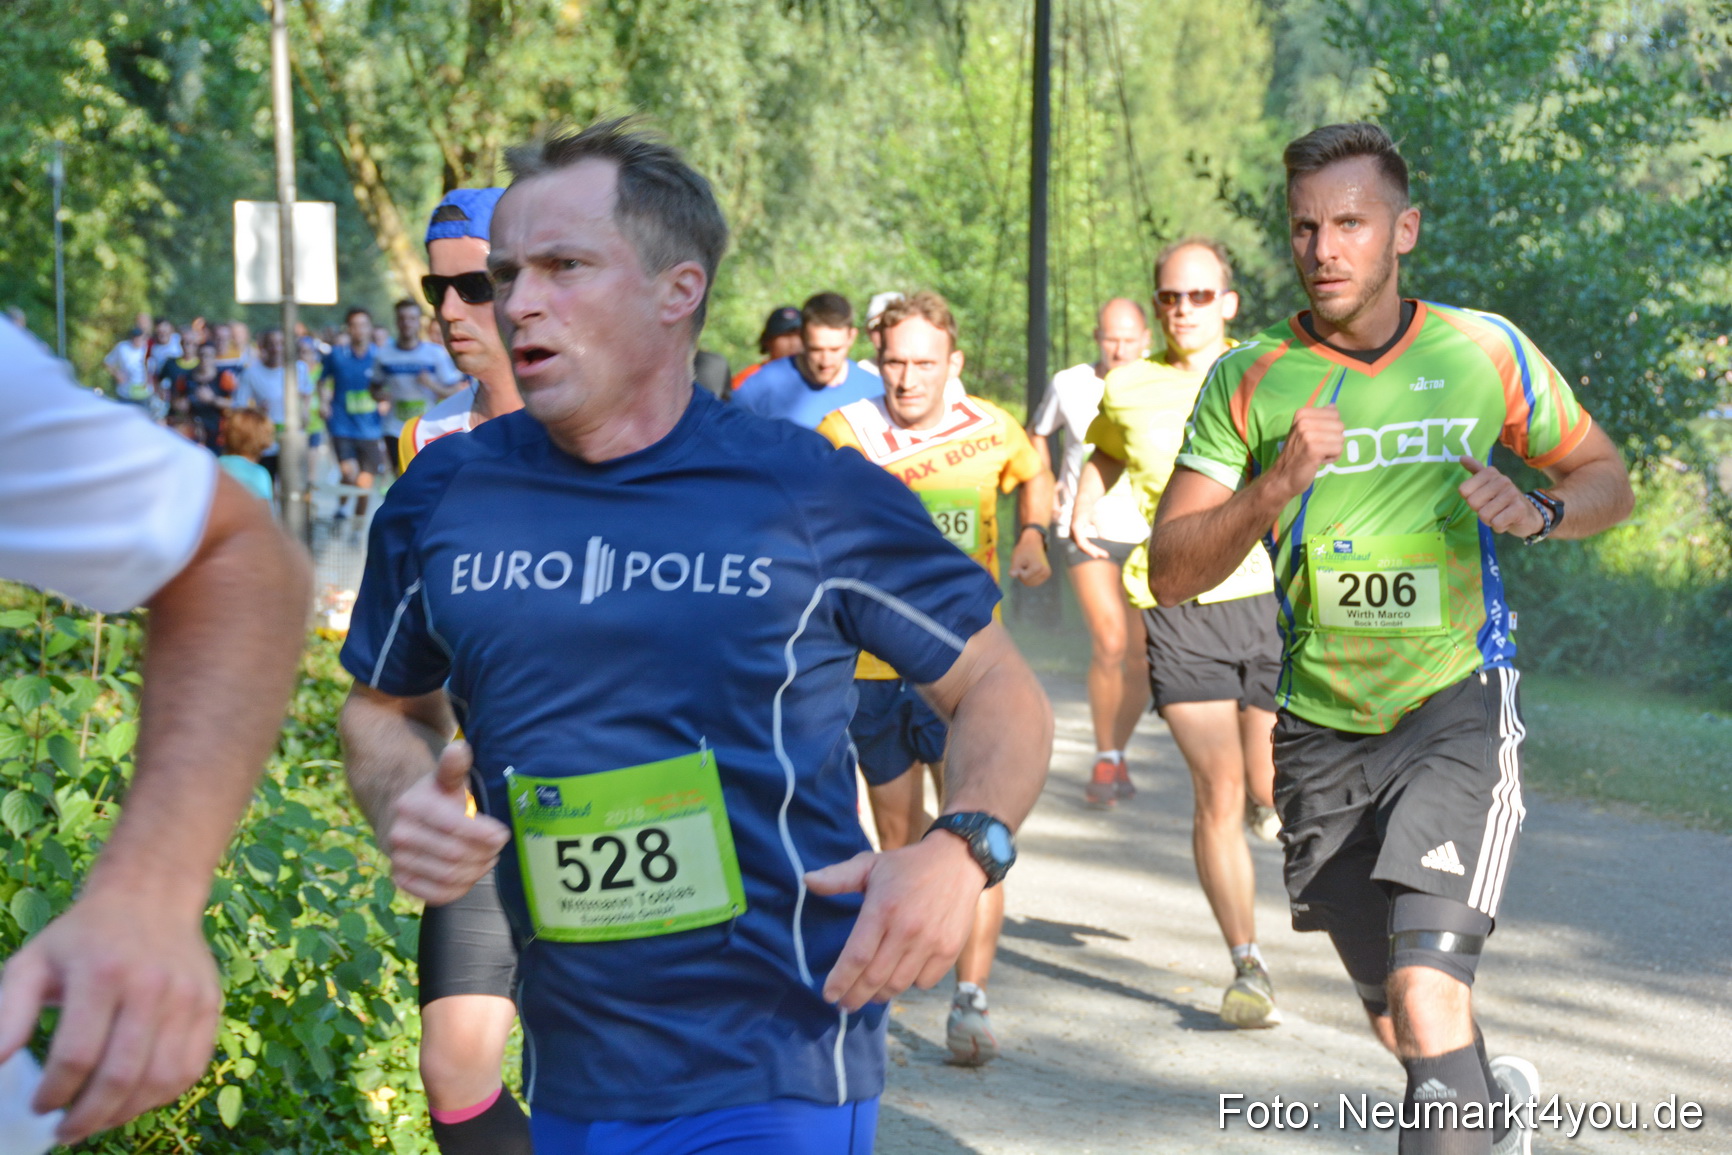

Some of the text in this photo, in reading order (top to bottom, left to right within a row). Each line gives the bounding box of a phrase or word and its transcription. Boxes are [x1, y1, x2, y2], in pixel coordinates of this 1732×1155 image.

[1315, 418, 1479, 478] OCK
[451, 550, 774, 598] EURO POLES
[1338, 573, 1417, 608] 206
[1347, 609, 1411, 620] Wirth Marco
[1354, 620, 1372, 628] Bock
[1381, 620, 1403, 628] GmbH
[556, 828, 678, 893] 528
